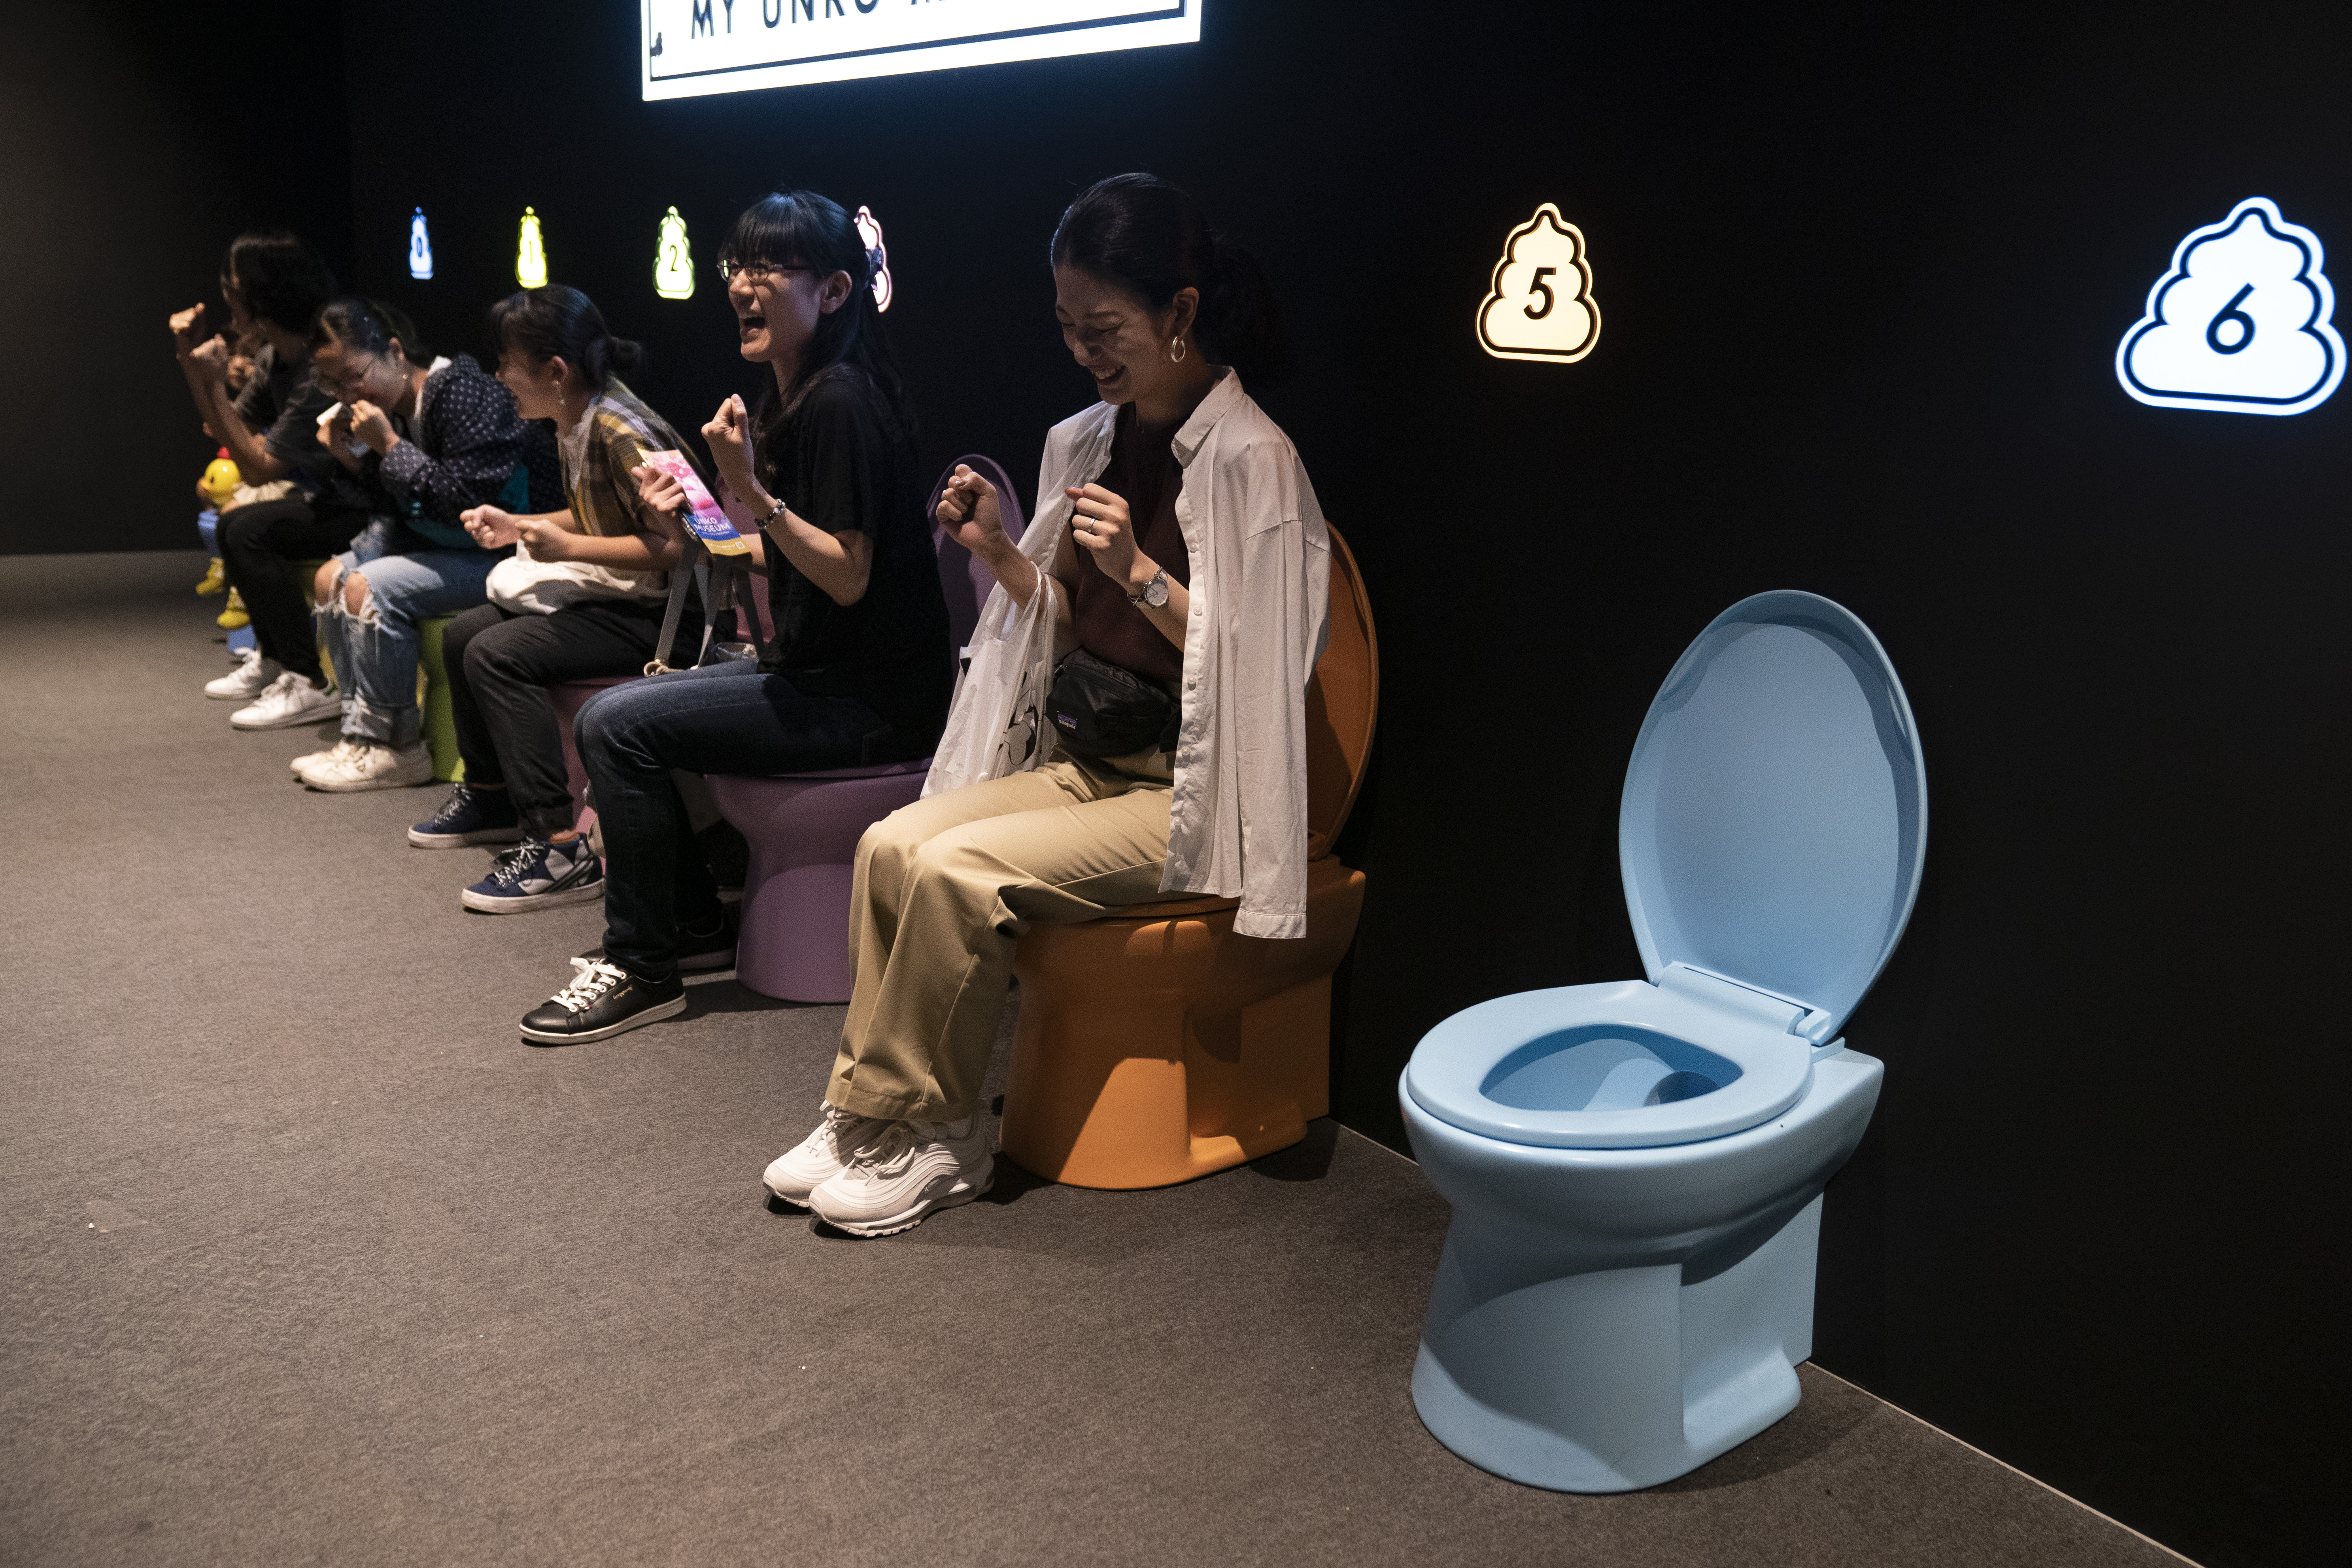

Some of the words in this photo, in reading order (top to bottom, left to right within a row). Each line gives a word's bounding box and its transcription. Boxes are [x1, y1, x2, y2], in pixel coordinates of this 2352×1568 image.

[691, 0, 734, 39] MY
[763, 0, 879, 28] UN
[669, 245, 678, 272] 2
[1523, 267, 1557, 320] 5
[2206, 282, 2256, 355] 6
[693, 523, 731, 532] MUSEUM
[1059, 720, 1075, 729] patagonia
